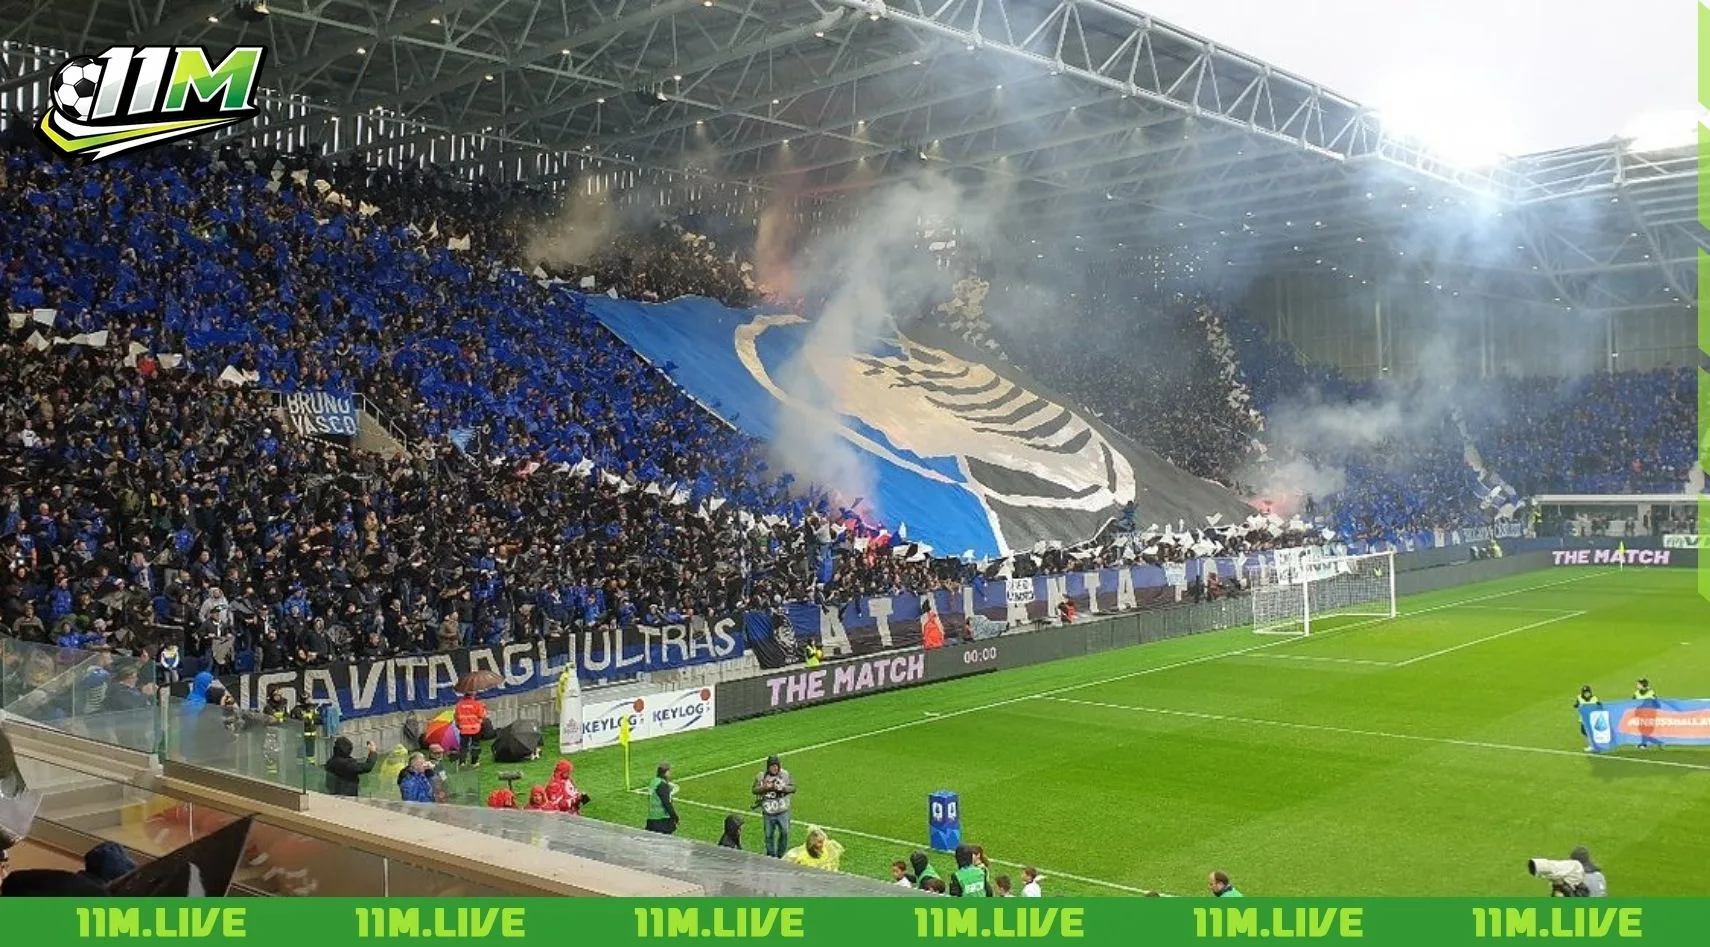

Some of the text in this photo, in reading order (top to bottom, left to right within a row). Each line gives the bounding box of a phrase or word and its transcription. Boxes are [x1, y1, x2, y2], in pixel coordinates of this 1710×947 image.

[291, 415, 357, 437] VASCO
[1552, 549, 1671, 565] THE MATCH
[584, 617, 736, 671] ULTRAS
[963, 647, 997, 664] 00:00
[766, 654, 926, 707] THE MATCH
[652, 703, 704, 722] KEYLOG
